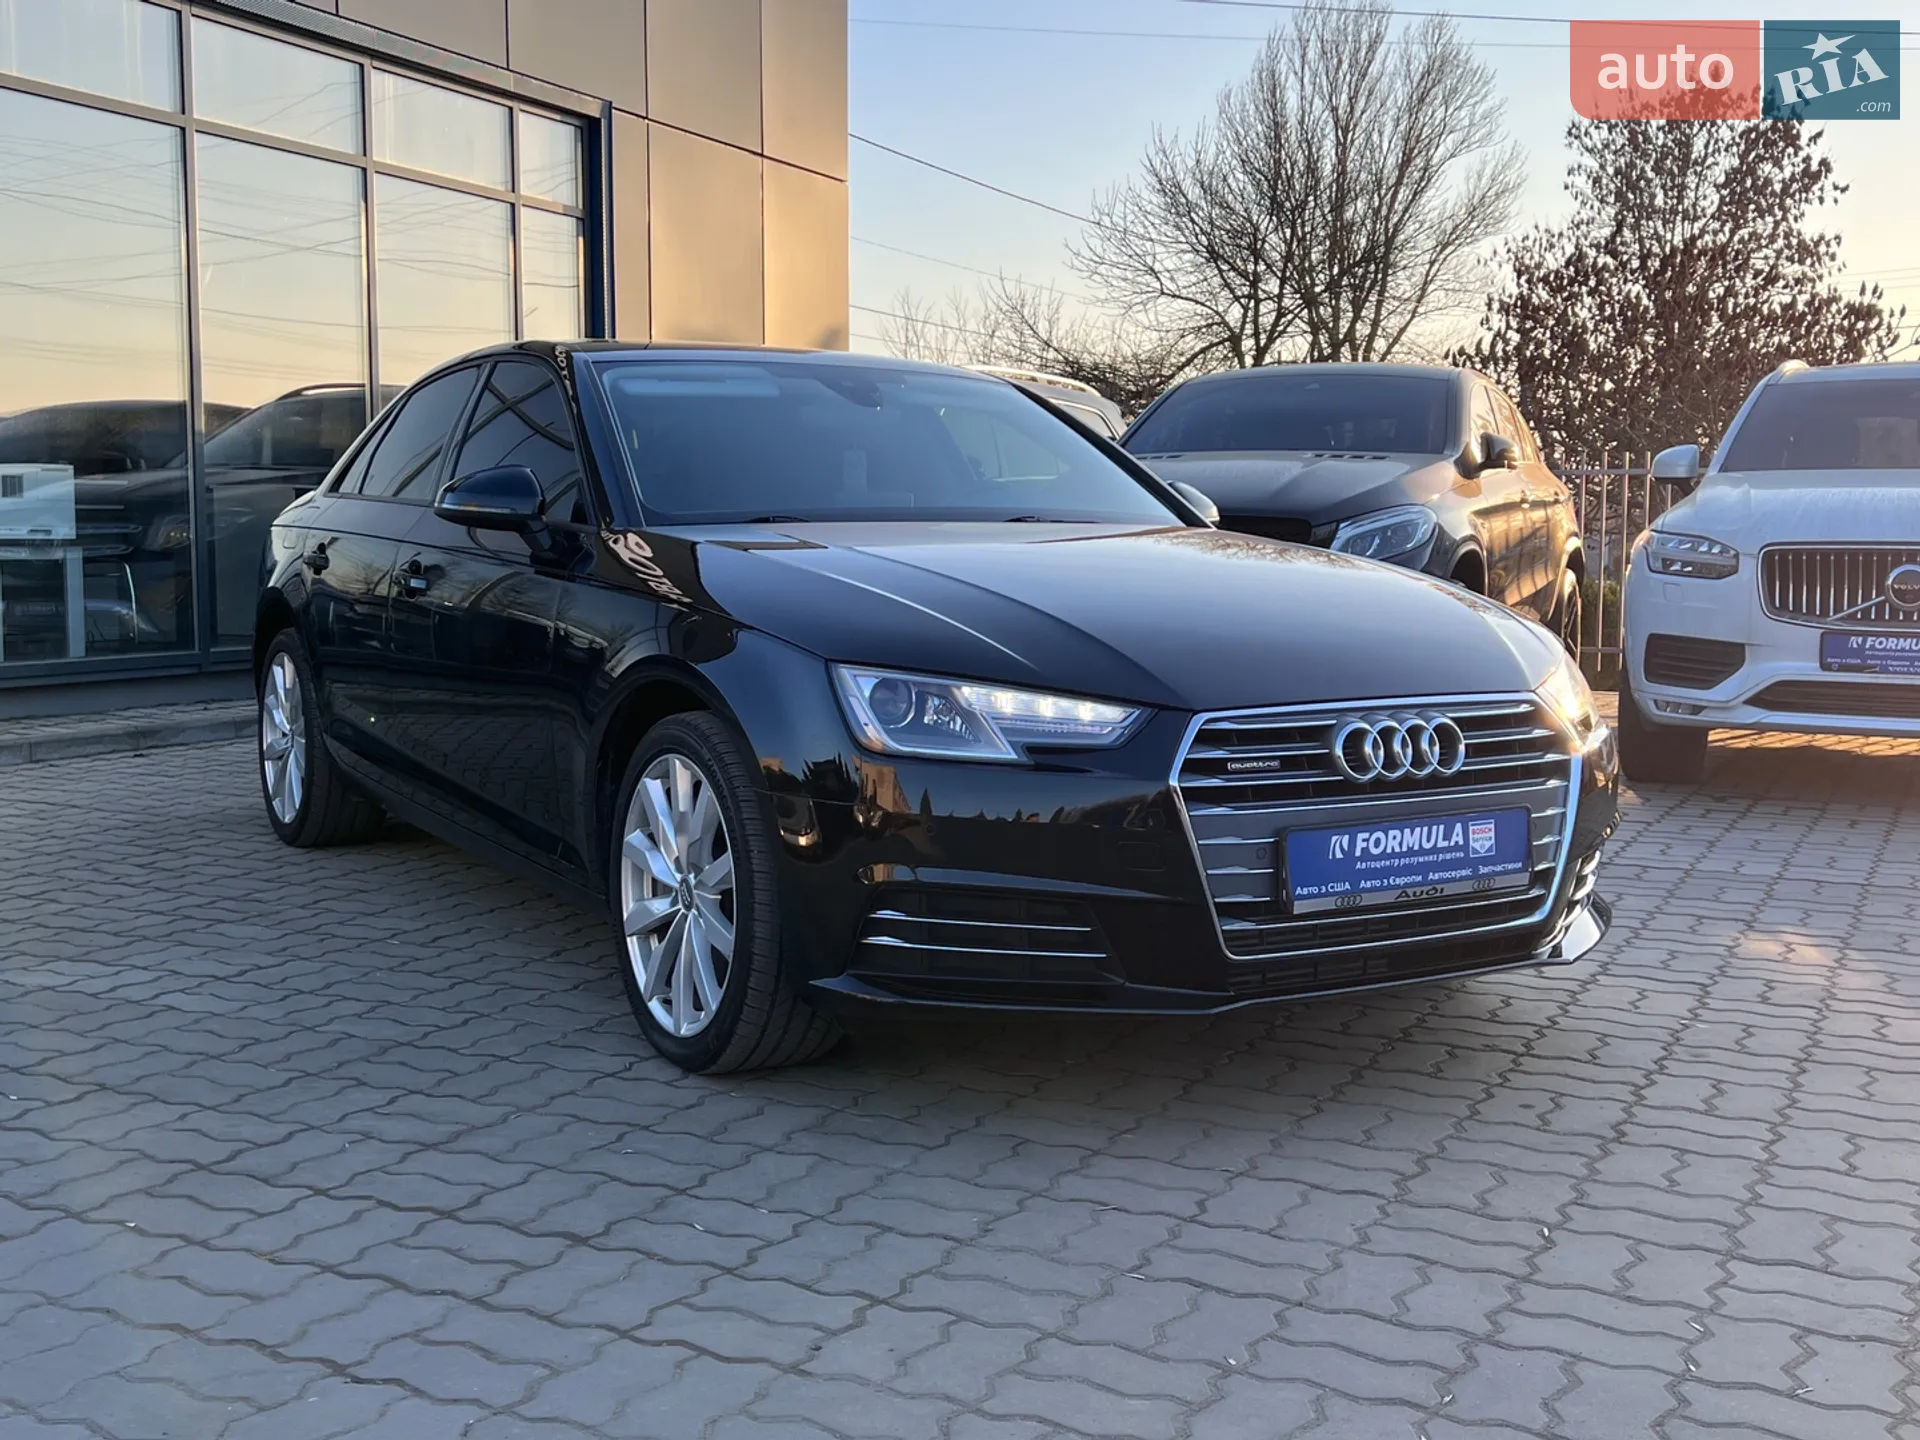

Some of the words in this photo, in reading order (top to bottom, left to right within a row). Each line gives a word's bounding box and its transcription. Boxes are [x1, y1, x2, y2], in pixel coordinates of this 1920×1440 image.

[1355, 822, 1464, 857] FORMULA
[1295, 886, 1319, 895] Авто
[1327, 881, 1351, 892] США
[1359, 879, 1381, 889] Авто
[1428, 867, 1473, 880] Автосервіс
